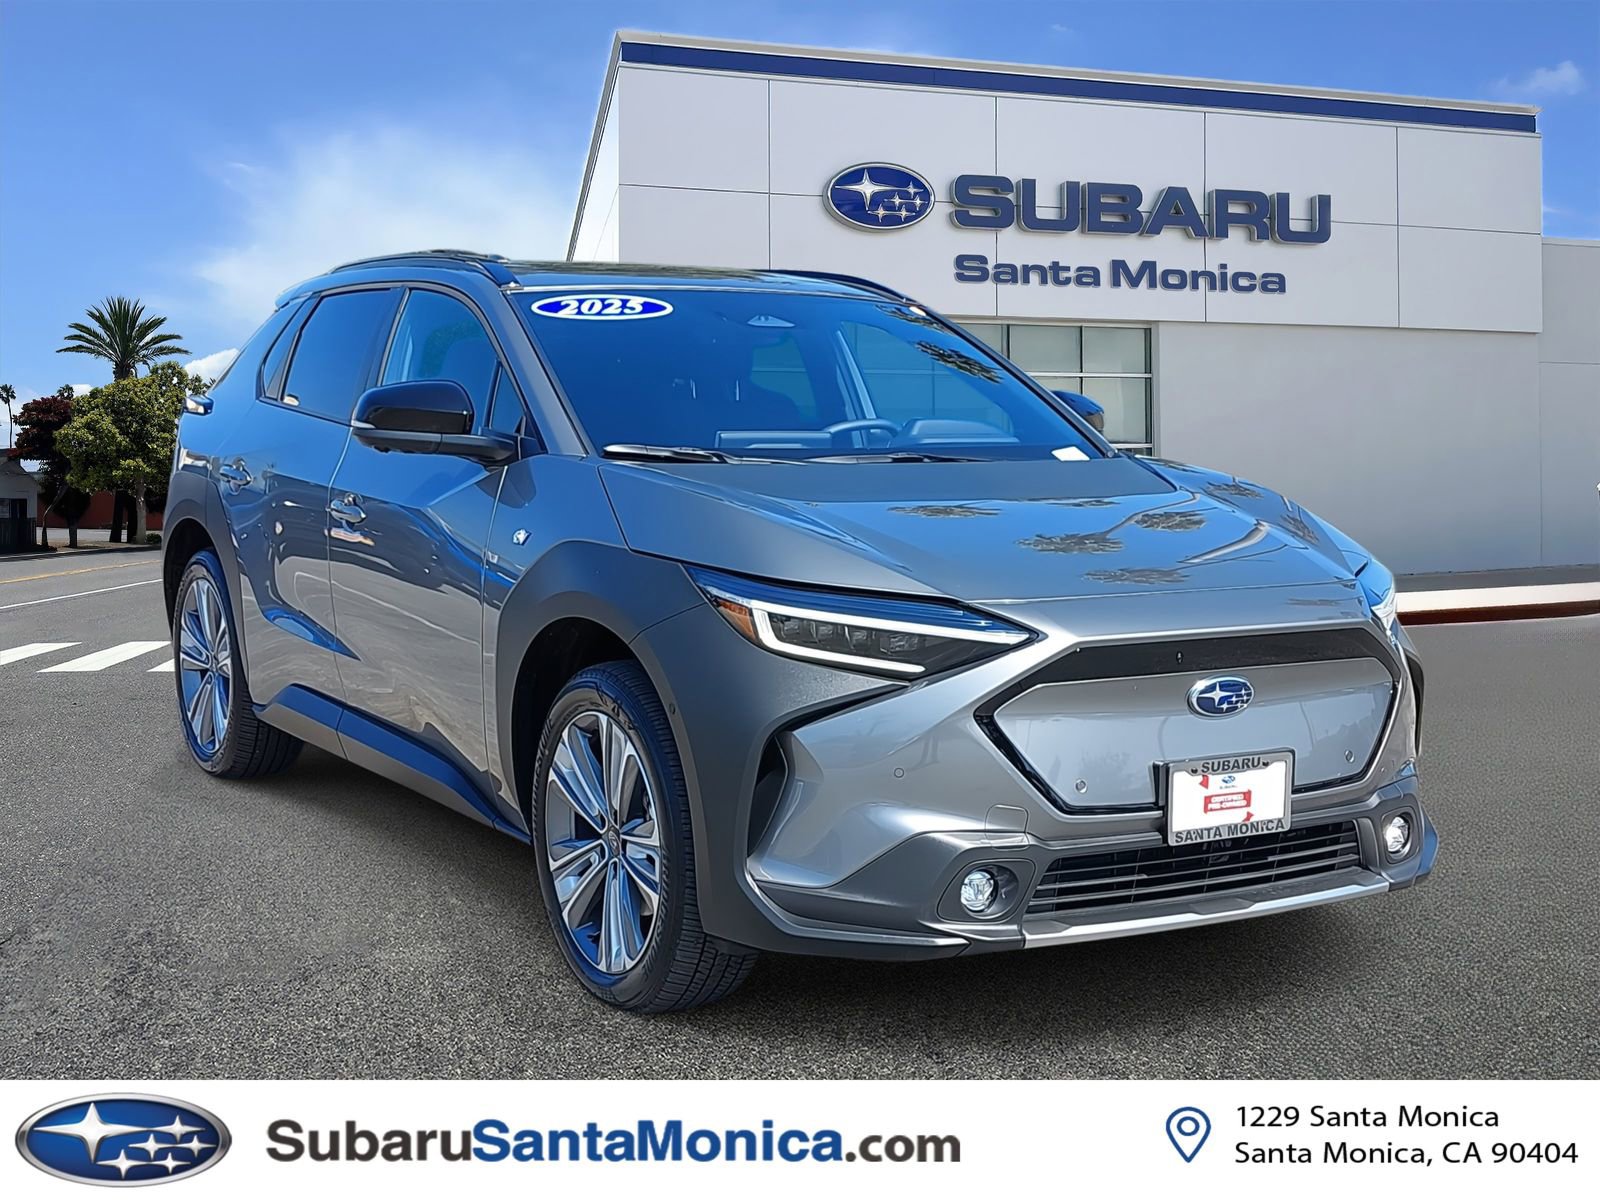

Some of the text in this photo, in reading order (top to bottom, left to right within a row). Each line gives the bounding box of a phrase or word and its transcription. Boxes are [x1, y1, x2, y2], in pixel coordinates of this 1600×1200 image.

[950, 173, 1332, 244] SUBARU
[954, 253, 1287, 294] Santa Monica
[555, 298, 646, 315] 2025
[1201, 756, 1261, 774] SUBARU
[1174, 819, 1286, 844] SANTA MONICA
